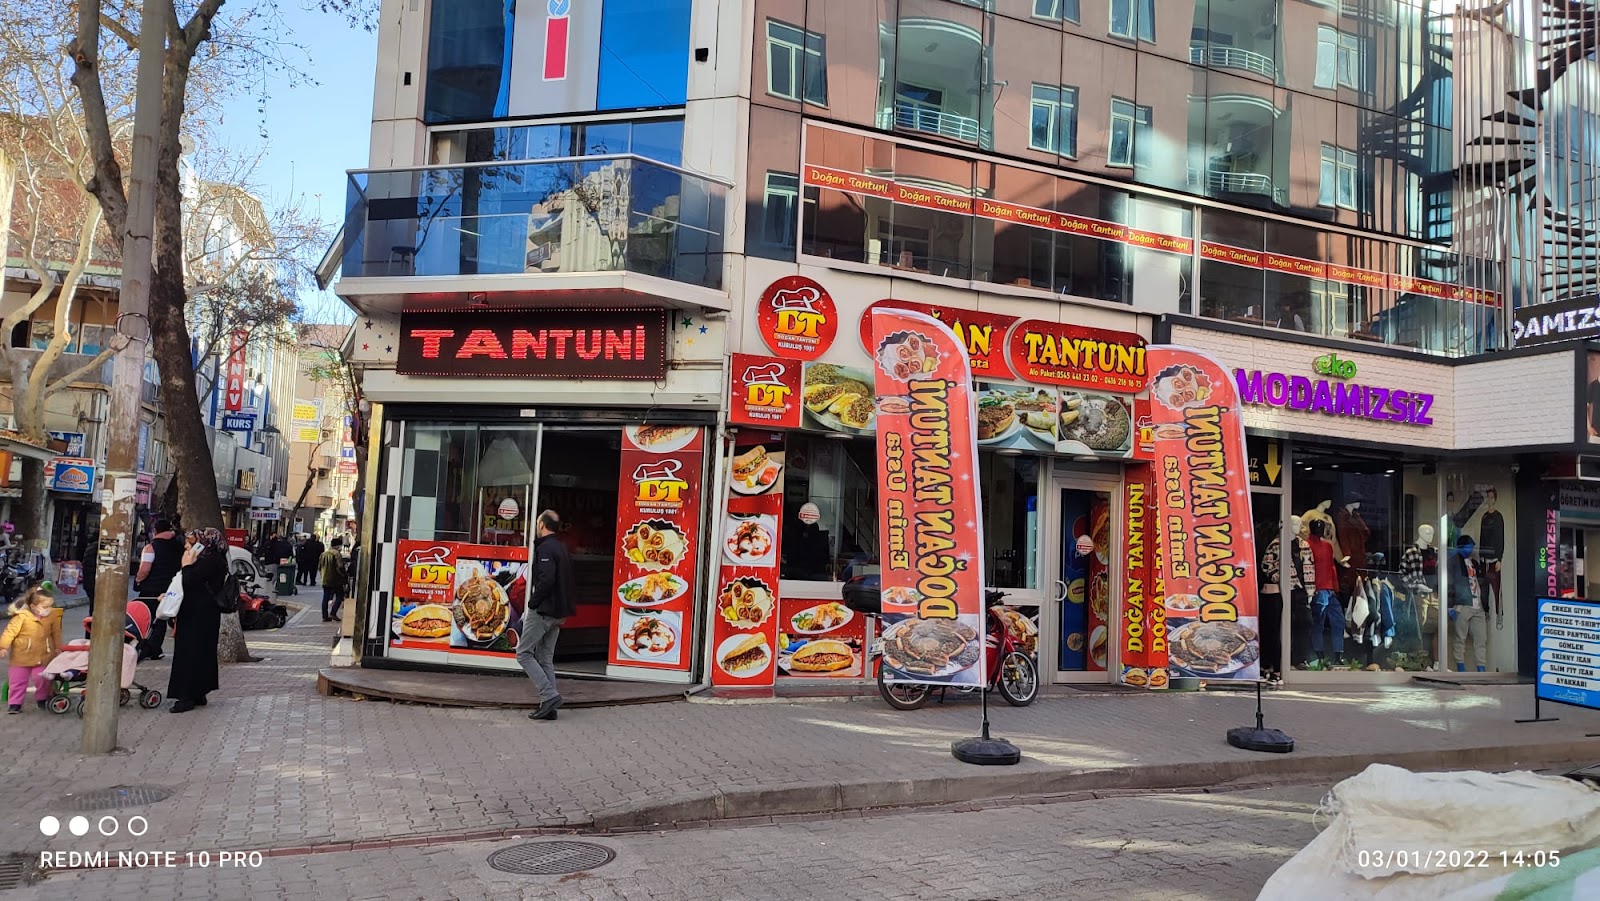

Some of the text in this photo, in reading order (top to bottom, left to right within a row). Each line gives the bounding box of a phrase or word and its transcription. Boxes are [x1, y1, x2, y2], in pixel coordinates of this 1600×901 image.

[811, 170, 888, 194] Doğan Tantuni
[899, 188, 972, 210] Doğan Tantuni
[982, 202, 1051, 224] Doğan Tantuni
[1060, 217, 1124, 238] Doğan Tantuni
[1129, 232, 1189, 251] Doğan Tantuni
[1201, 244, 1259, 264] Doğan Tantuni
[1268, 257, 1323, 275] Doğan Tantuni
[1332, 268, 1384, 286] Doğan Tantuni
[1416, 281, 1441, 294] Tantuni
[774, 311, 826, 338] DT
[410, 325, 646, 361] TANTUNİ
[970, 359, 989, 369] sta
[1024, 332, 1147, 376] TANTUNİ
[1313, 353, 1357, 379] eko
[746, 384, 791, 408] DT
[226, 419, 252, 429] KURS
[637, 480, 688, 502] DT
[409, 565, 456, 585] DT
[1123, 483, 1145, 653] DOĞAN TANTUNİ
[1552, 605, 1573, 613] ERKEK
